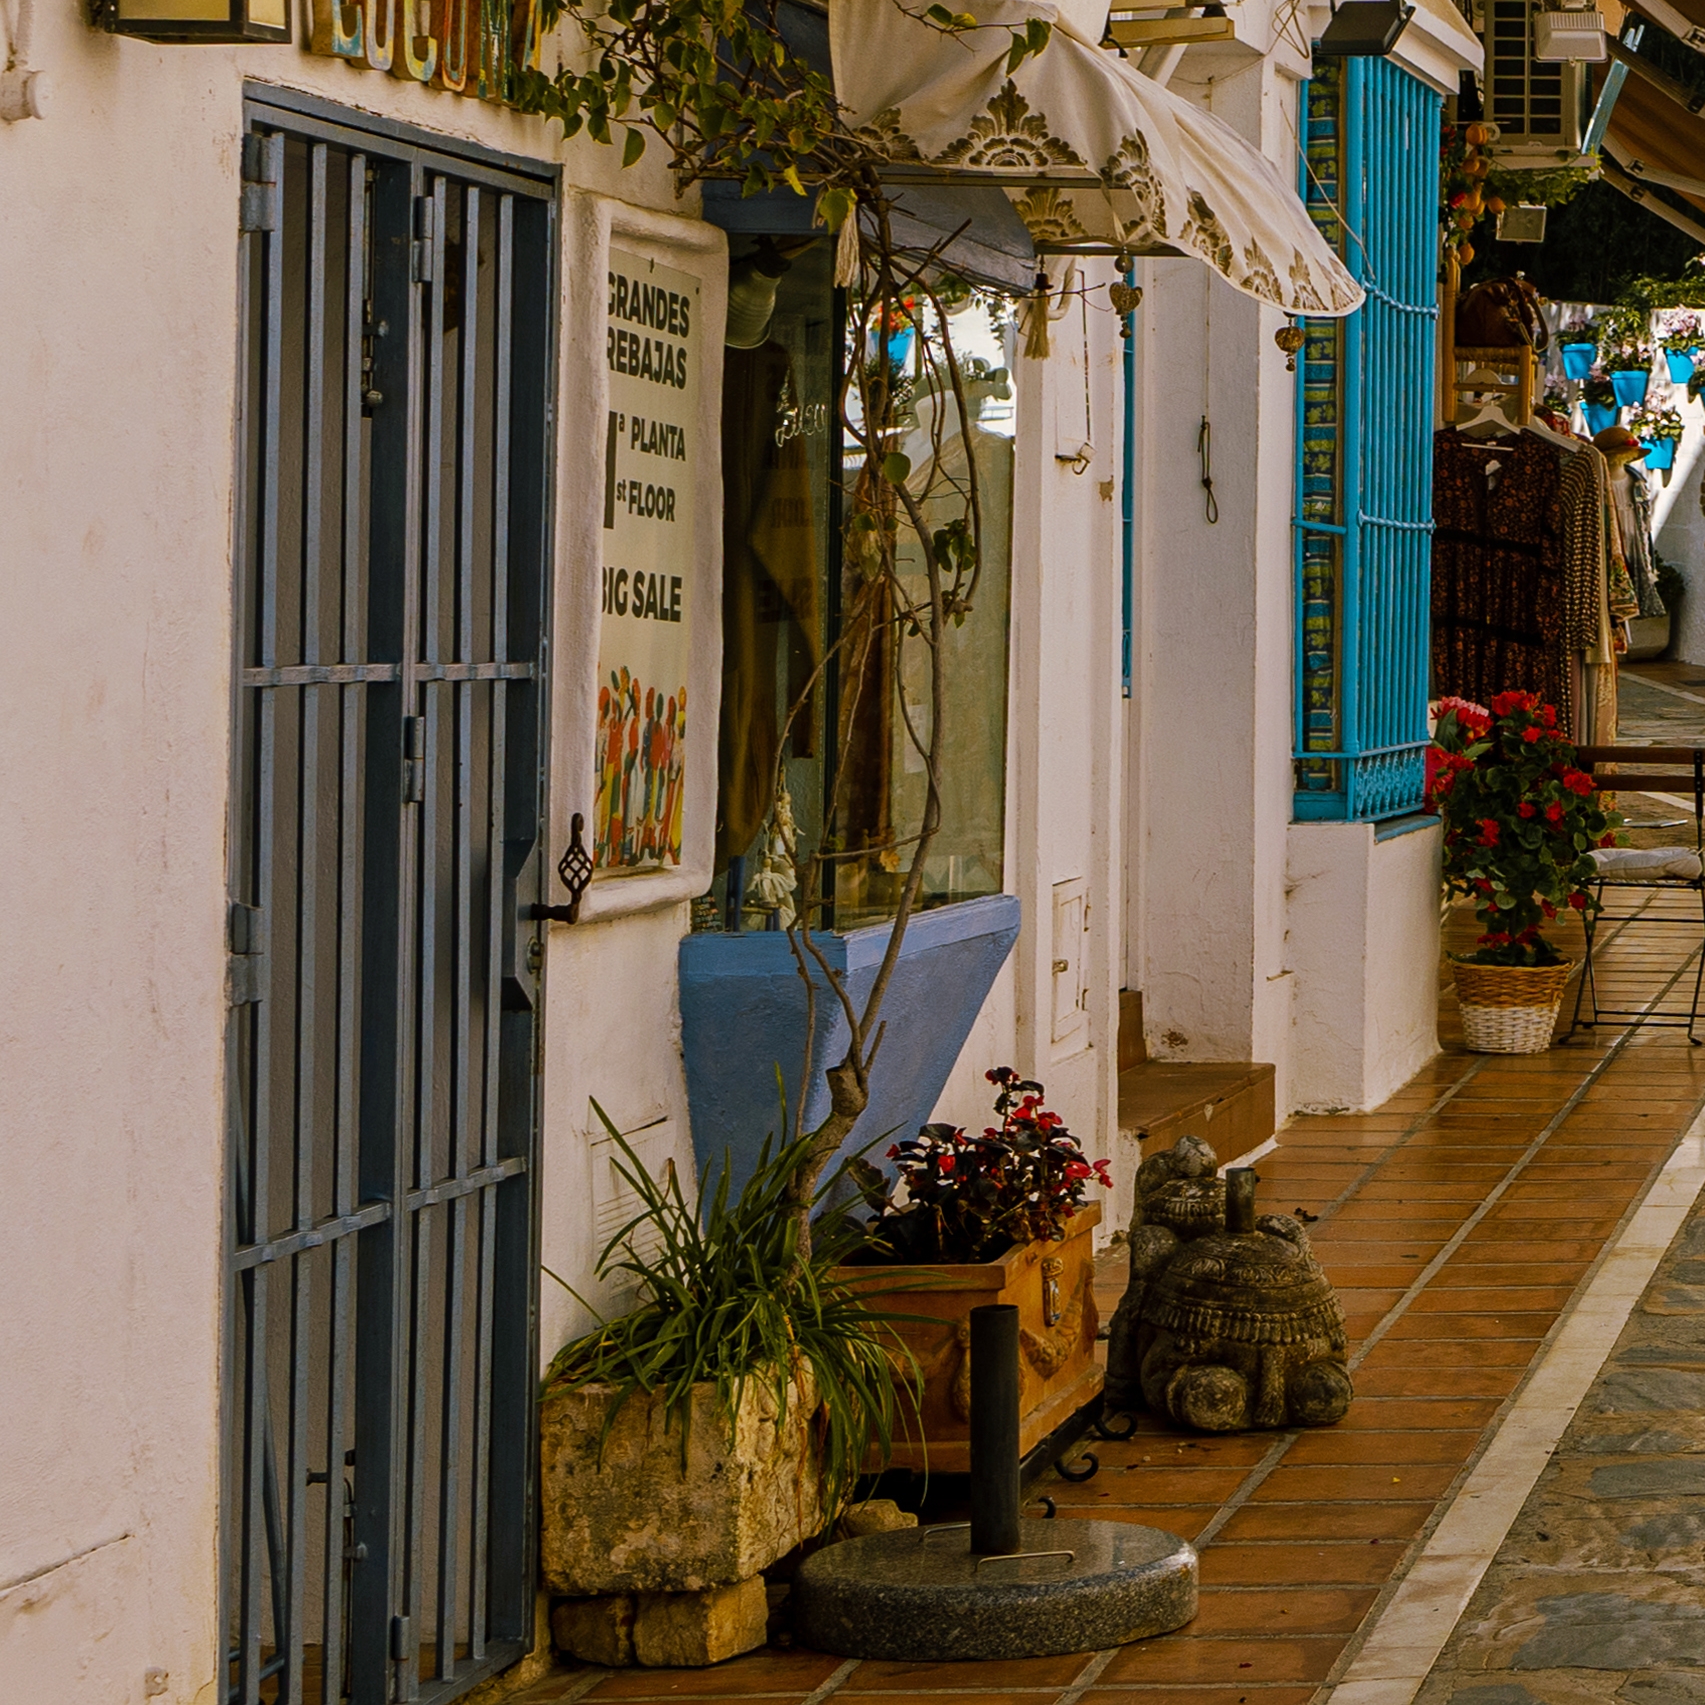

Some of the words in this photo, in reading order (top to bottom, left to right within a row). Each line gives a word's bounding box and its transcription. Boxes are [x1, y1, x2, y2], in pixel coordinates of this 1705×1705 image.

[608, 271, 690, 338] GRANDES
[607, 326, 687, 390] REBAJAS
[630, 416, 686, 462] PLANTA
[628, 480, 675, 522] FLOOR
[632, 570, 683, 623] SALE
